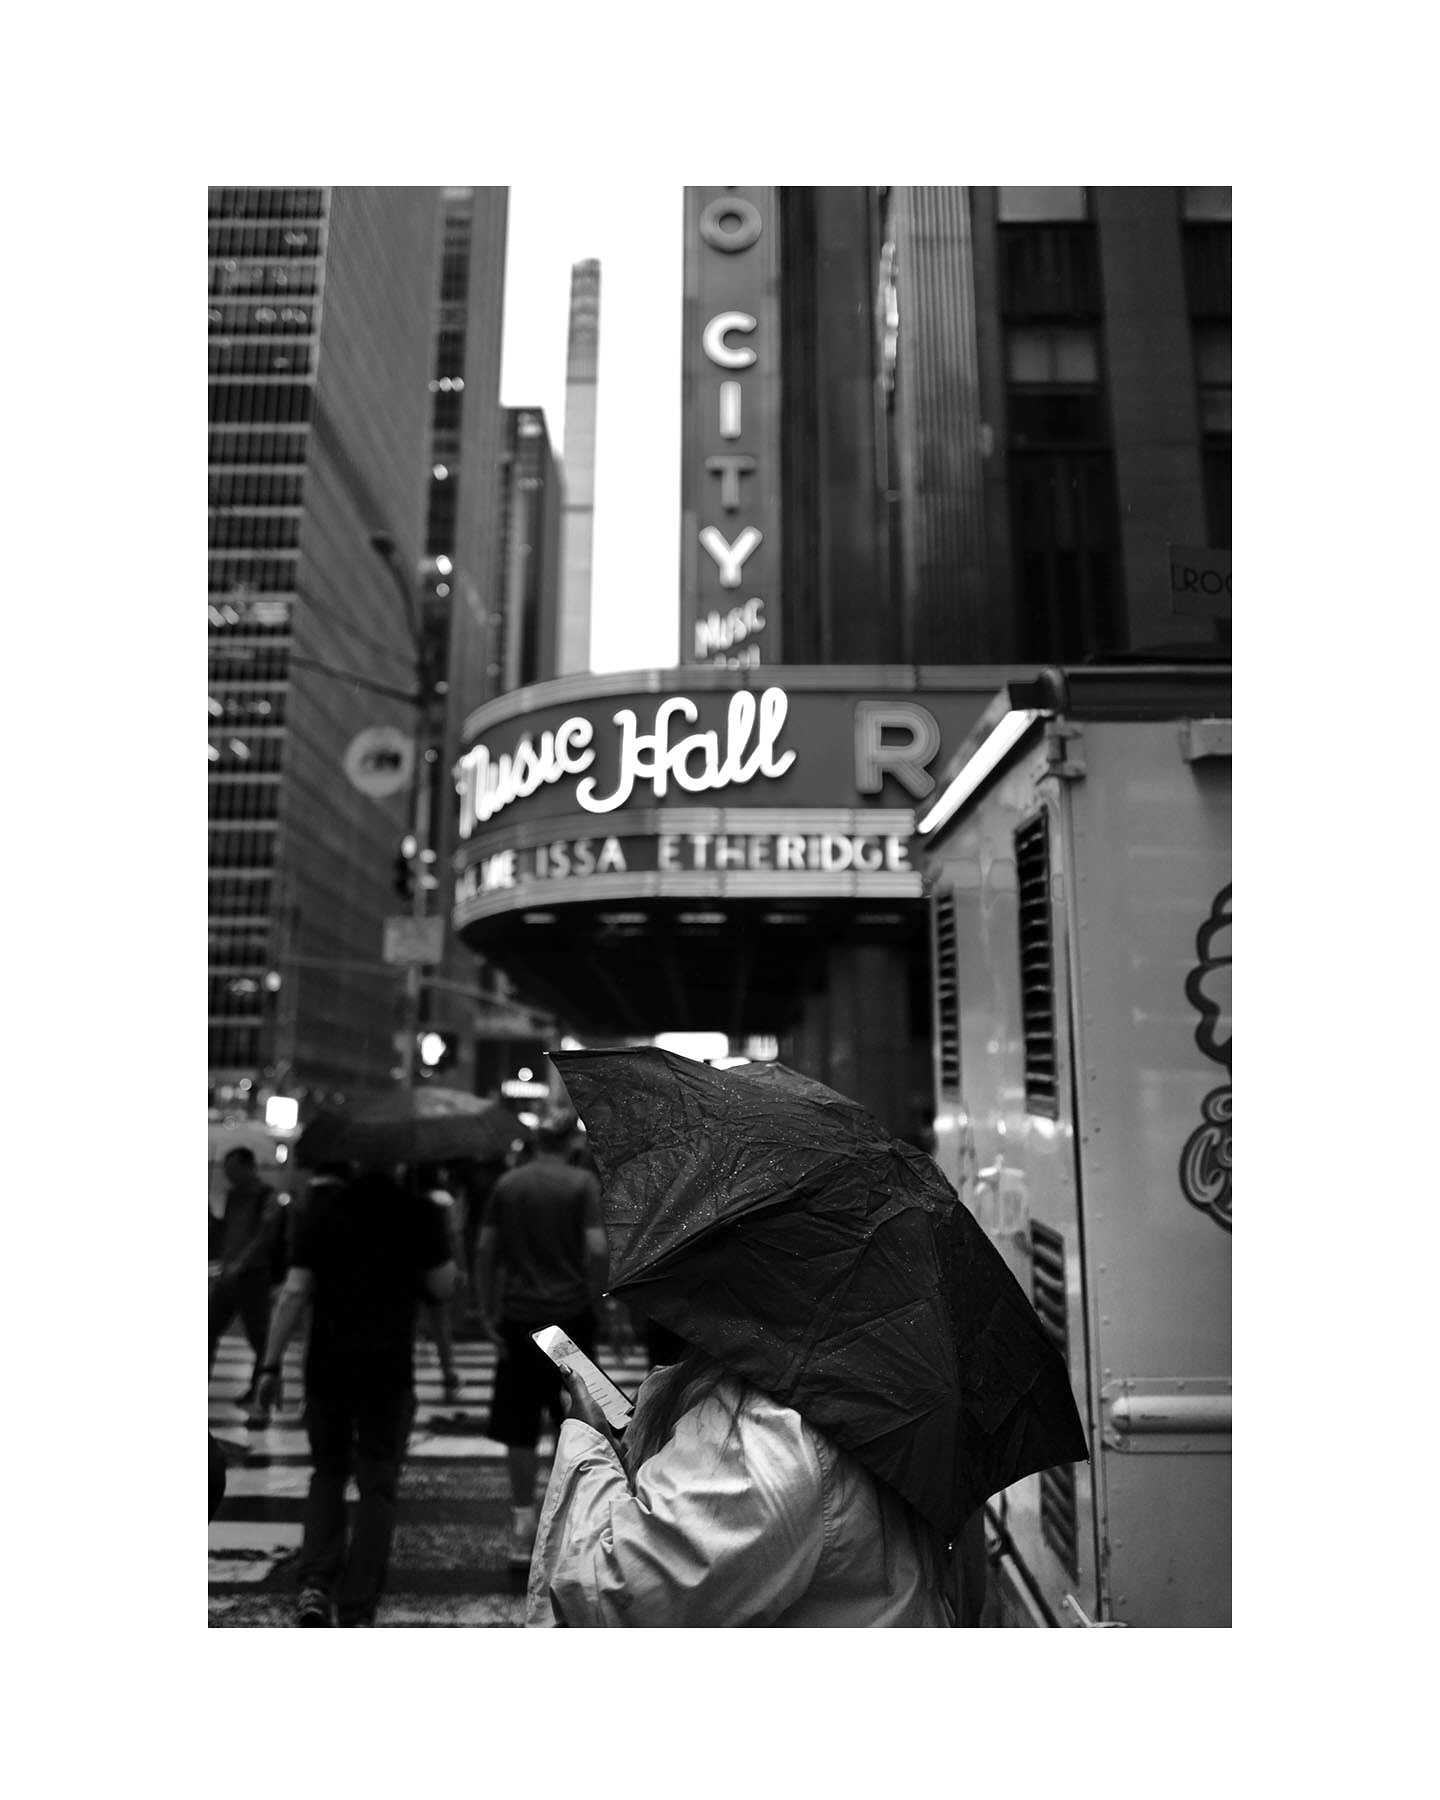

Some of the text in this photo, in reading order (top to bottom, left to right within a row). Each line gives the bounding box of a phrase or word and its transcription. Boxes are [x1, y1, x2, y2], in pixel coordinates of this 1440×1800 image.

[700, 311, 763, 588] CITY
[454, 687, 796, 838] Music Hall
[658, 834, 912, 872] ETHERIDGE
